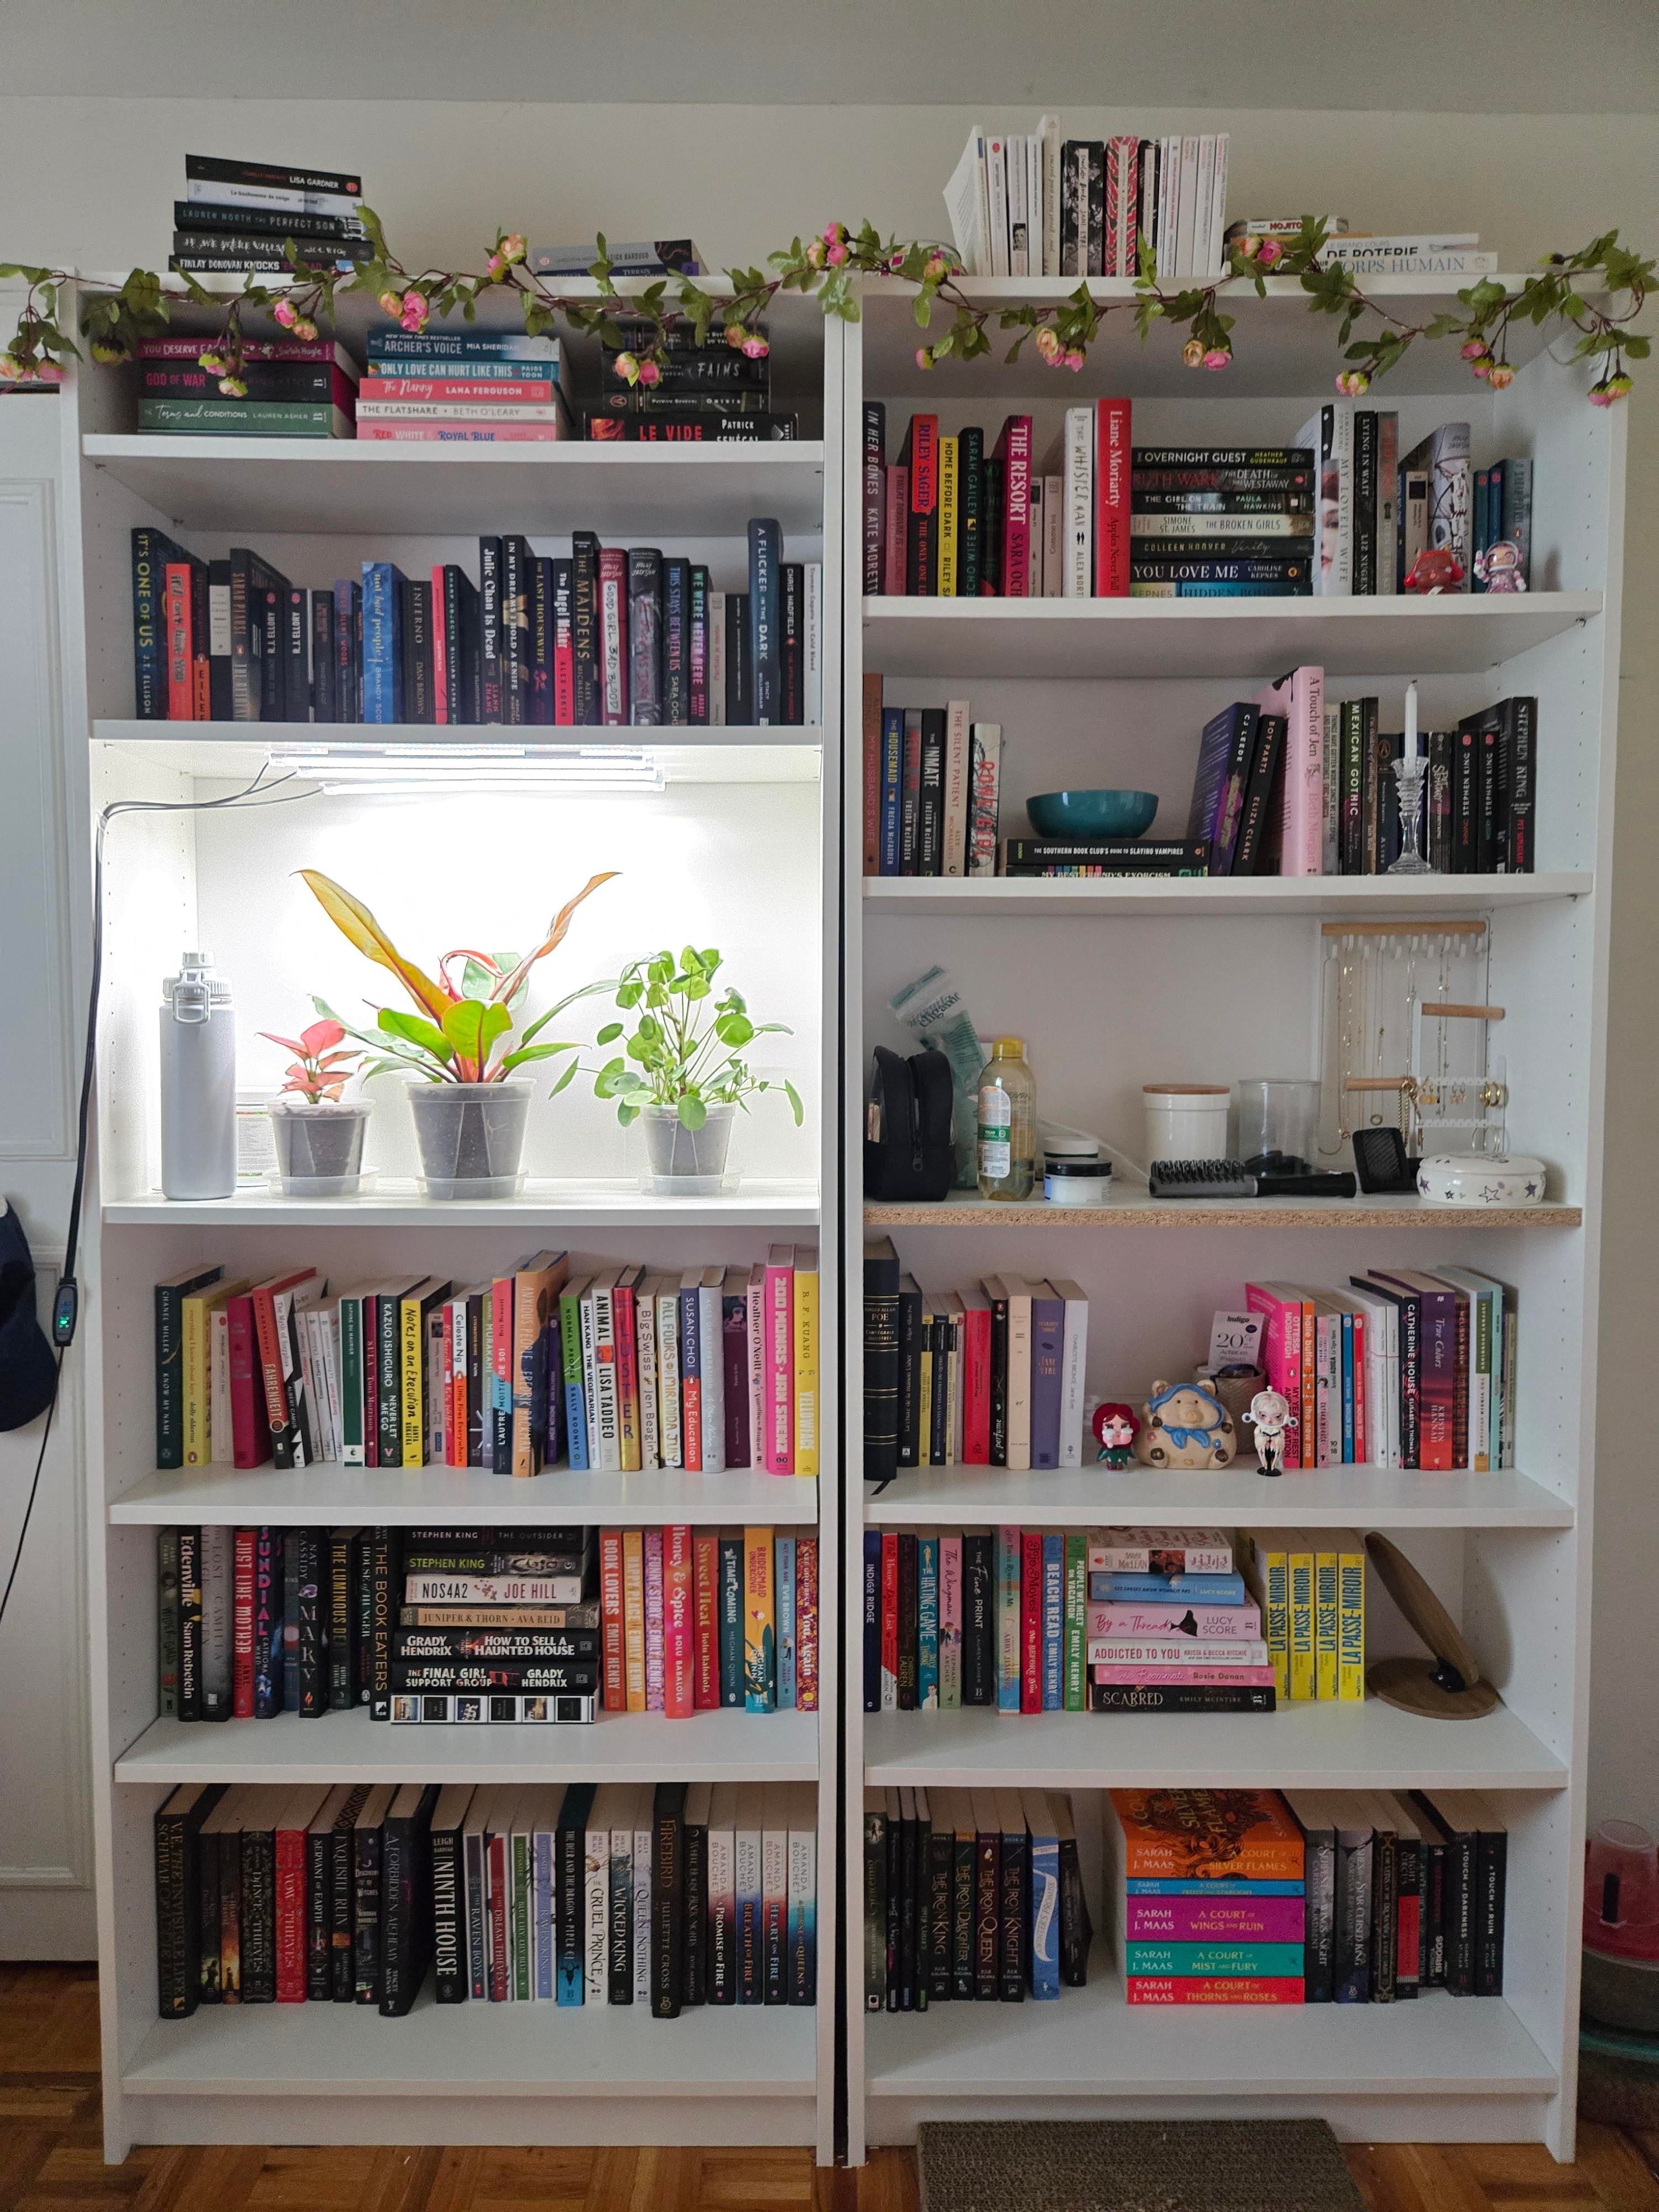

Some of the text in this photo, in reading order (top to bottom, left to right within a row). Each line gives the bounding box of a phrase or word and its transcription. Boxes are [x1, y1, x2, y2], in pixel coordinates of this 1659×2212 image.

[290, 176, 338, 189] LISA GARDNER
[180, 259, 279, 270] FINLAY DONOVAN KNOCKS
[1393, 257, 1464, 271] HUMAIN
[385, 340, 462, 354] ARCHER'S VOICE
[381, 364, 512, 377] ONLY LOVE CAN HURT LIKE THIS
[640, 426, 702, 441] LE VIDE
[867, 410, 879, 495] IN HER BONES
[1008, 425, 1026, 525] THE RESORT
[1106, 410, 1122, 508] Liane Moriarty
[1144, 452, 1246, 463] OVERNIGHT GUEST
[941, 443, 953, 538] HOME BEFORE DARK
[138, 535, 148, 558] IT'S
[758, 528, 767, 592] A FLICKER
[137, 563, 150, 598] ONE
[1135, 566, 1238, 578] YOU LOVE ME
[484, 549, 496, 660] Julie Chan Is Dead
[576, 580, 589, 659] MAIDENS
[785, 596, 794, 635] HADFIELD
[138, 627, 153, 648] US
[758, 624, 768, 660] DARK
[1309, 677, 1321, 757] A Touch of Jen
[888, 732, 898, 783] HOUSEMAID
[924, 747, 939, 787] INMATE
[1350, 768, 1359, 816] GOTHIC
[597, 1295, 609, 1341] ANIMAL
[872, 1312, 888, 1321] POE
[384, 1303, 393, 1387] KAZUO ISHIGURO
[455, 1350, 464, 1363] Ng
[640, 1311, 651, 1371] Big Swiss
[405, 1308, 418, 1418] Notes on an Execution
[599, 1368, 614, 1439] LISA TADDEO
[687, 1391, 696, 1463] My Education
[181, 1536, 195, 1606] Edenville
[410, 1558, 485, 1568] STEPHEN KING
[604, 1539, 619, 1615] BOOK LOVERS
[757, 1547, 766, 1597] BRIDESMAID
[422, 1583, 468, 1598] NOS4A2
[504, 1584, 557, 1599] JOE HILL
[920, 1577, 936, 1641] HATING GAME
[1047, 1563, 1059, 1637] BEACH READ
[376, 1545, 387, 1691] THE BOOK EATERS
[1203, 1625, 1237, 1634] SCORE
[1342, 1567, 1361, 1665] LA PASSE-MIROIR
[401, 1646, 452, 1656] HENDRIX
[407, 1636, 447, 1646] GRADY
[474, 1645, 575, 1655] HAUNTED HOUSE
[484, 1636, 511, 1645] HOW
[533, 1636, 556, 1645] SELL
[559, 1637, 566, 1645] A
[1095, 1649, 1142, 1660] ADDICTED
[1161, 1648, 1180, 1658] YOU
[423, 1668, 456, 1678] FINAL
[460, 1668, 486, 1678] GIRL
[1103, 1693, 1163, 1706] SCARRED
[434, 1861, 456, 1975] NINTH HOUSE
[591, 1888, 605, 1976] CRUEL PRINCE
[613, 1888, 626, 1972] WICKED KING
[716, 1908, 724, 1950] PROMISE
[1145, 1922, 1174, 1930] MAAS
[978, 1917, 998, 1963] QUEEN
[1005, 1918, 1021, 1965] KNIGHT
